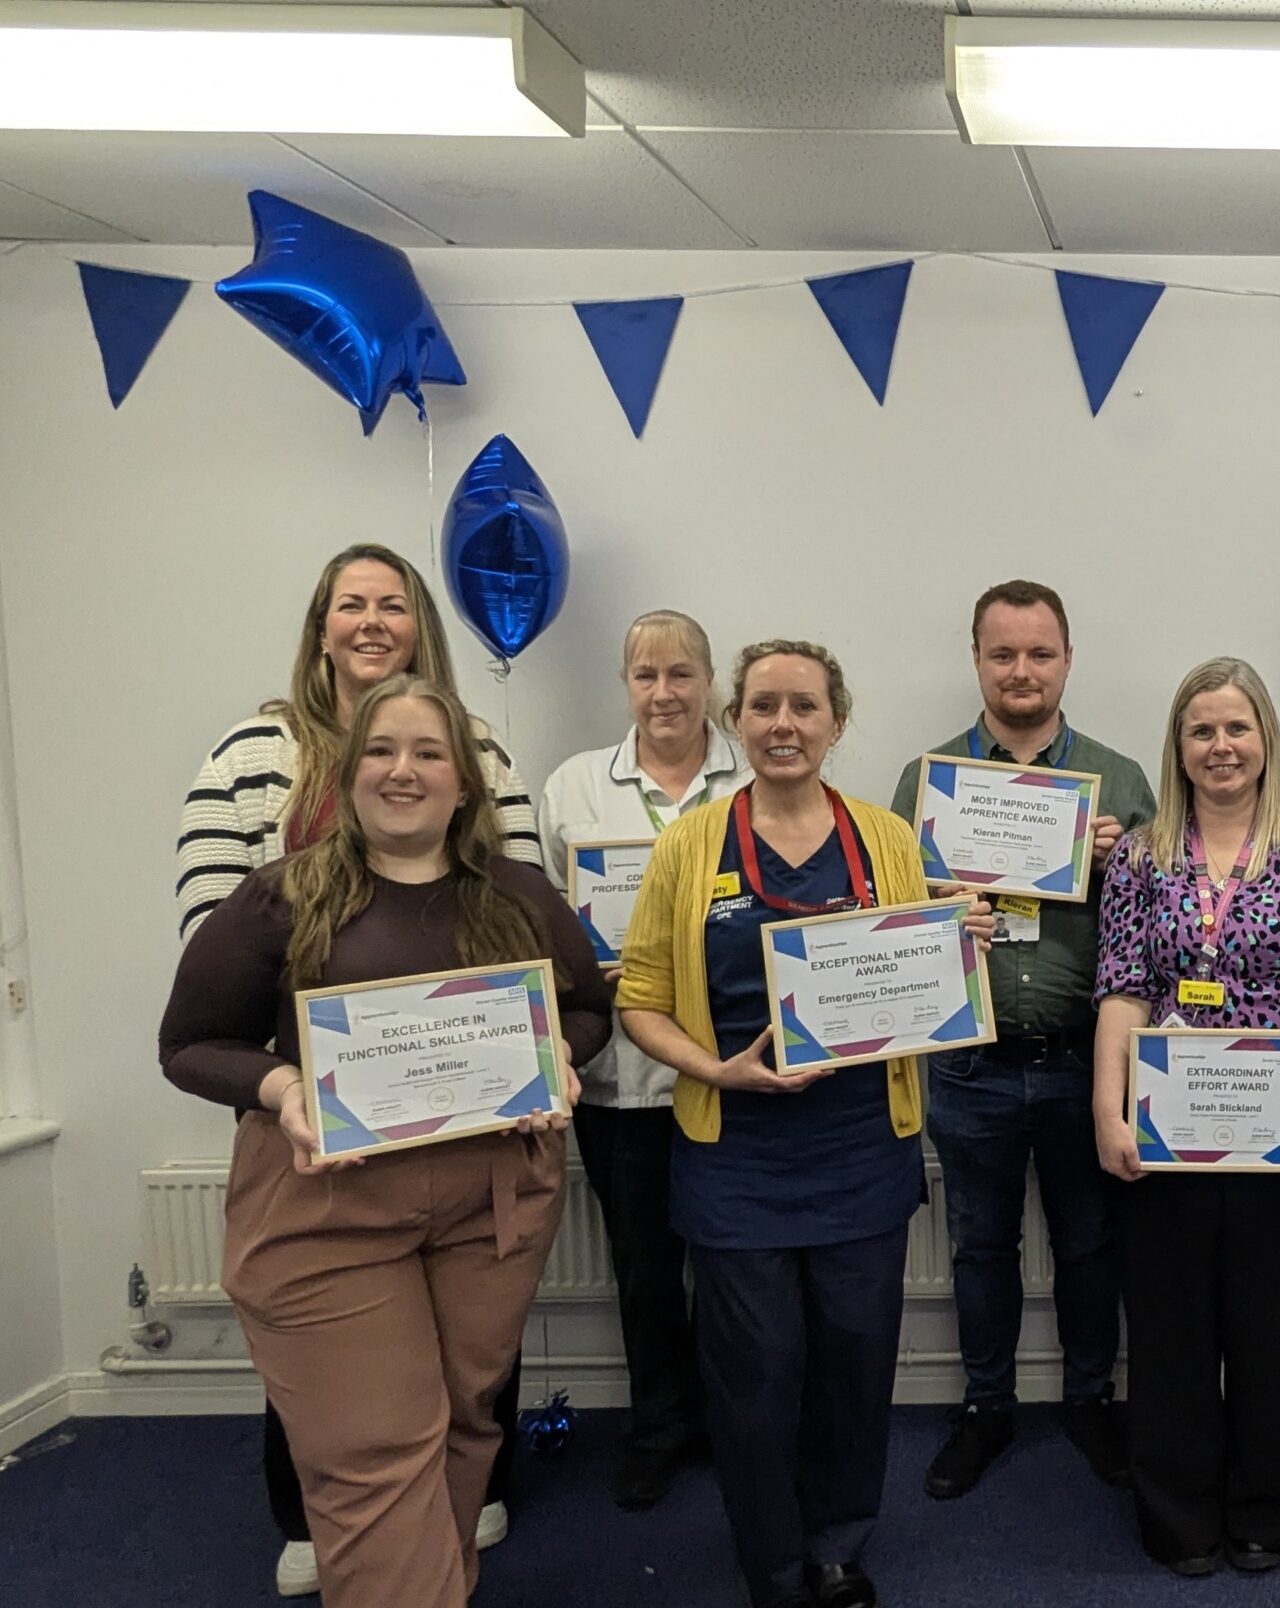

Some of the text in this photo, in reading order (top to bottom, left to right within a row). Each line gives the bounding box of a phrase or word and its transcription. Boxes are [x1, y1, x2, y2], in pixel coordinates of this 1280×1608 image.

[970, 795, 999, 807] MOST
[999, 798, 1050, 812] IMPROVED
[959, 806, 1019, 822] APPRENTICE
[1021, 814, 1058, 826] AWARD
[972, 827, 1033, 842] Kieran Pitman
[1003, 898, 1033, 913] Kieran
[810, 944, 943, 972] EXCEPTIONAL MENTOR
[855, 962, 899, 977] AWARD
[818, 988, 878, 1005] Emergency
[880, 979, 940, 997] Department
[1186, 991, 1215, 1001] Sarah
[381, 1013, 487, 1039] EXCELLENCE IN
[337, 1040, 426, 1063] FUNCTIONAL
[429, 1031, 475, 1049] SKILLS
[478, 1023, 528, 1040] AWARD
[404, 1066, 433, 1079] Jess
[436, 1059, 470, 1074] Miller
[1186, 1067, 1274, 1078] EXTRAORDINARY
[1188, 1081, 1270, 1092] EFFORT AWARD
[1189, 1102, 1262, 1113] Sarah Stickland
